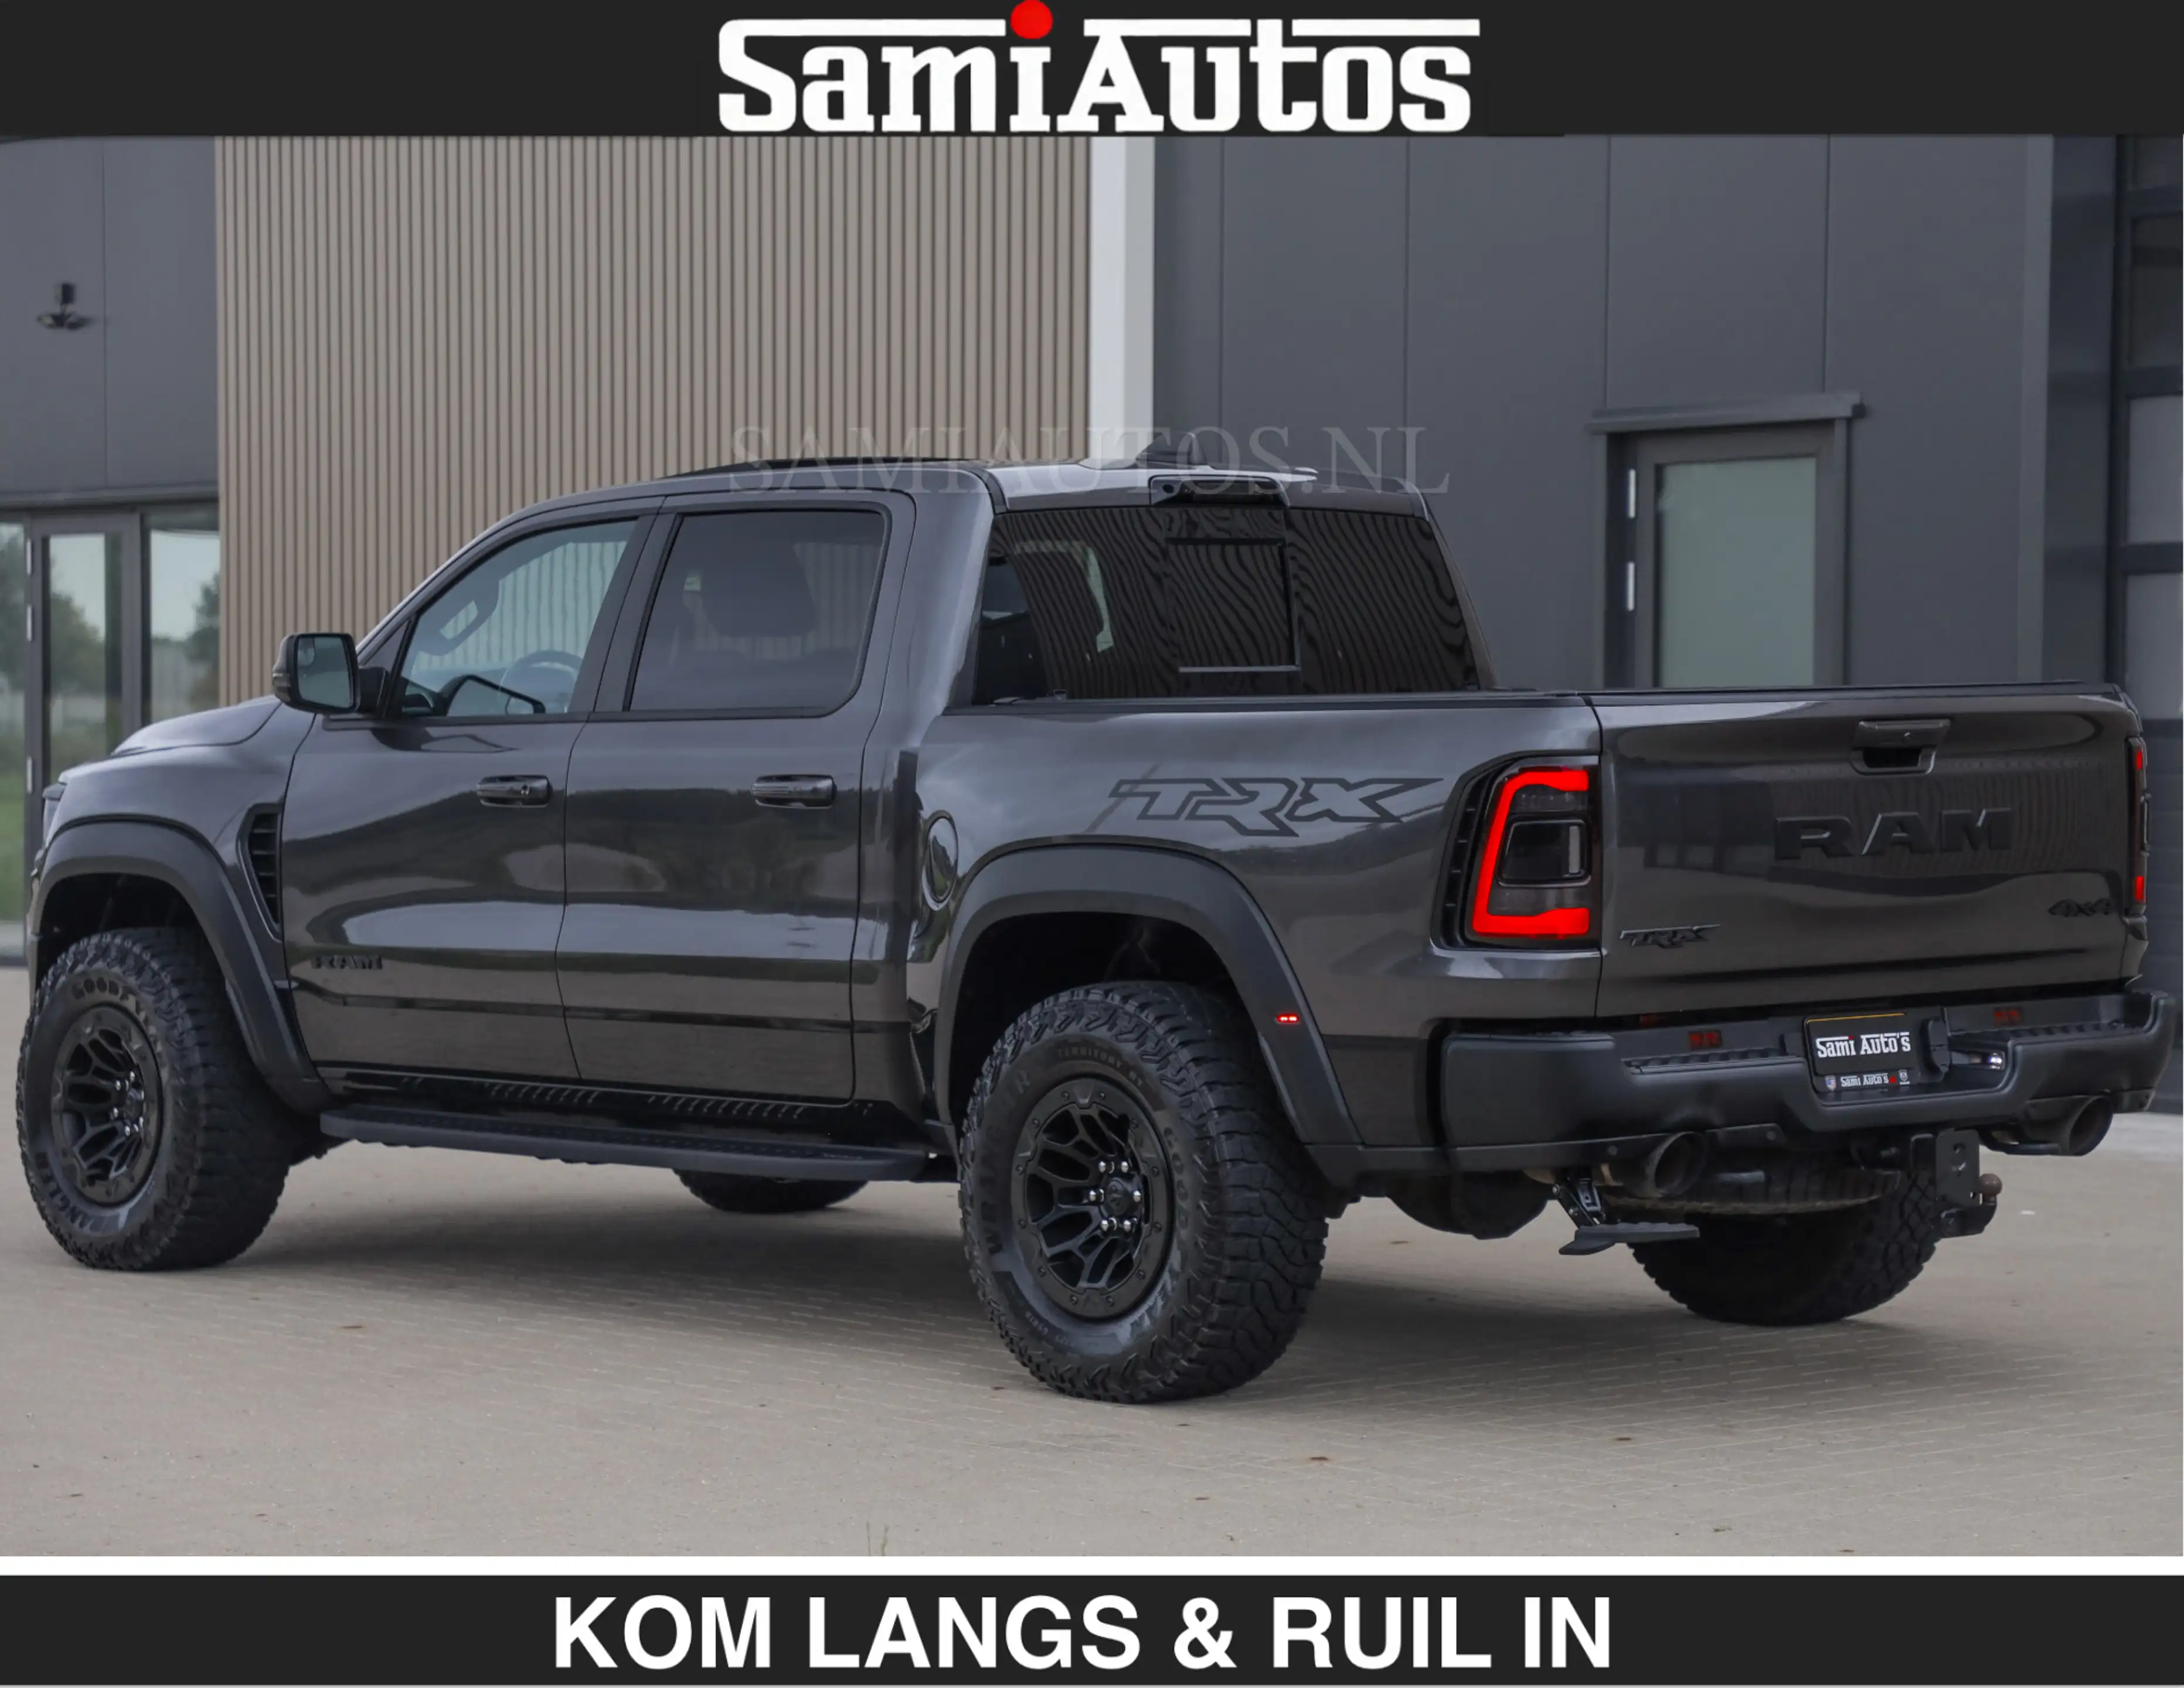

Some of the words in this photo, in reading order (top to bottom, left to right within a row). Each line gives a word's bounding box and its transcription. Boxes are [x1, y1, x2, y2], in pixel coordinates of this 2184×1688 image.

[1108, 778, 1444, 838] TRX
[1774, 807, 2012, 860] RAM
[1816, 1036, 1857, 1058] Sami
[1860, 1032, 1911, 1055] Auto's
